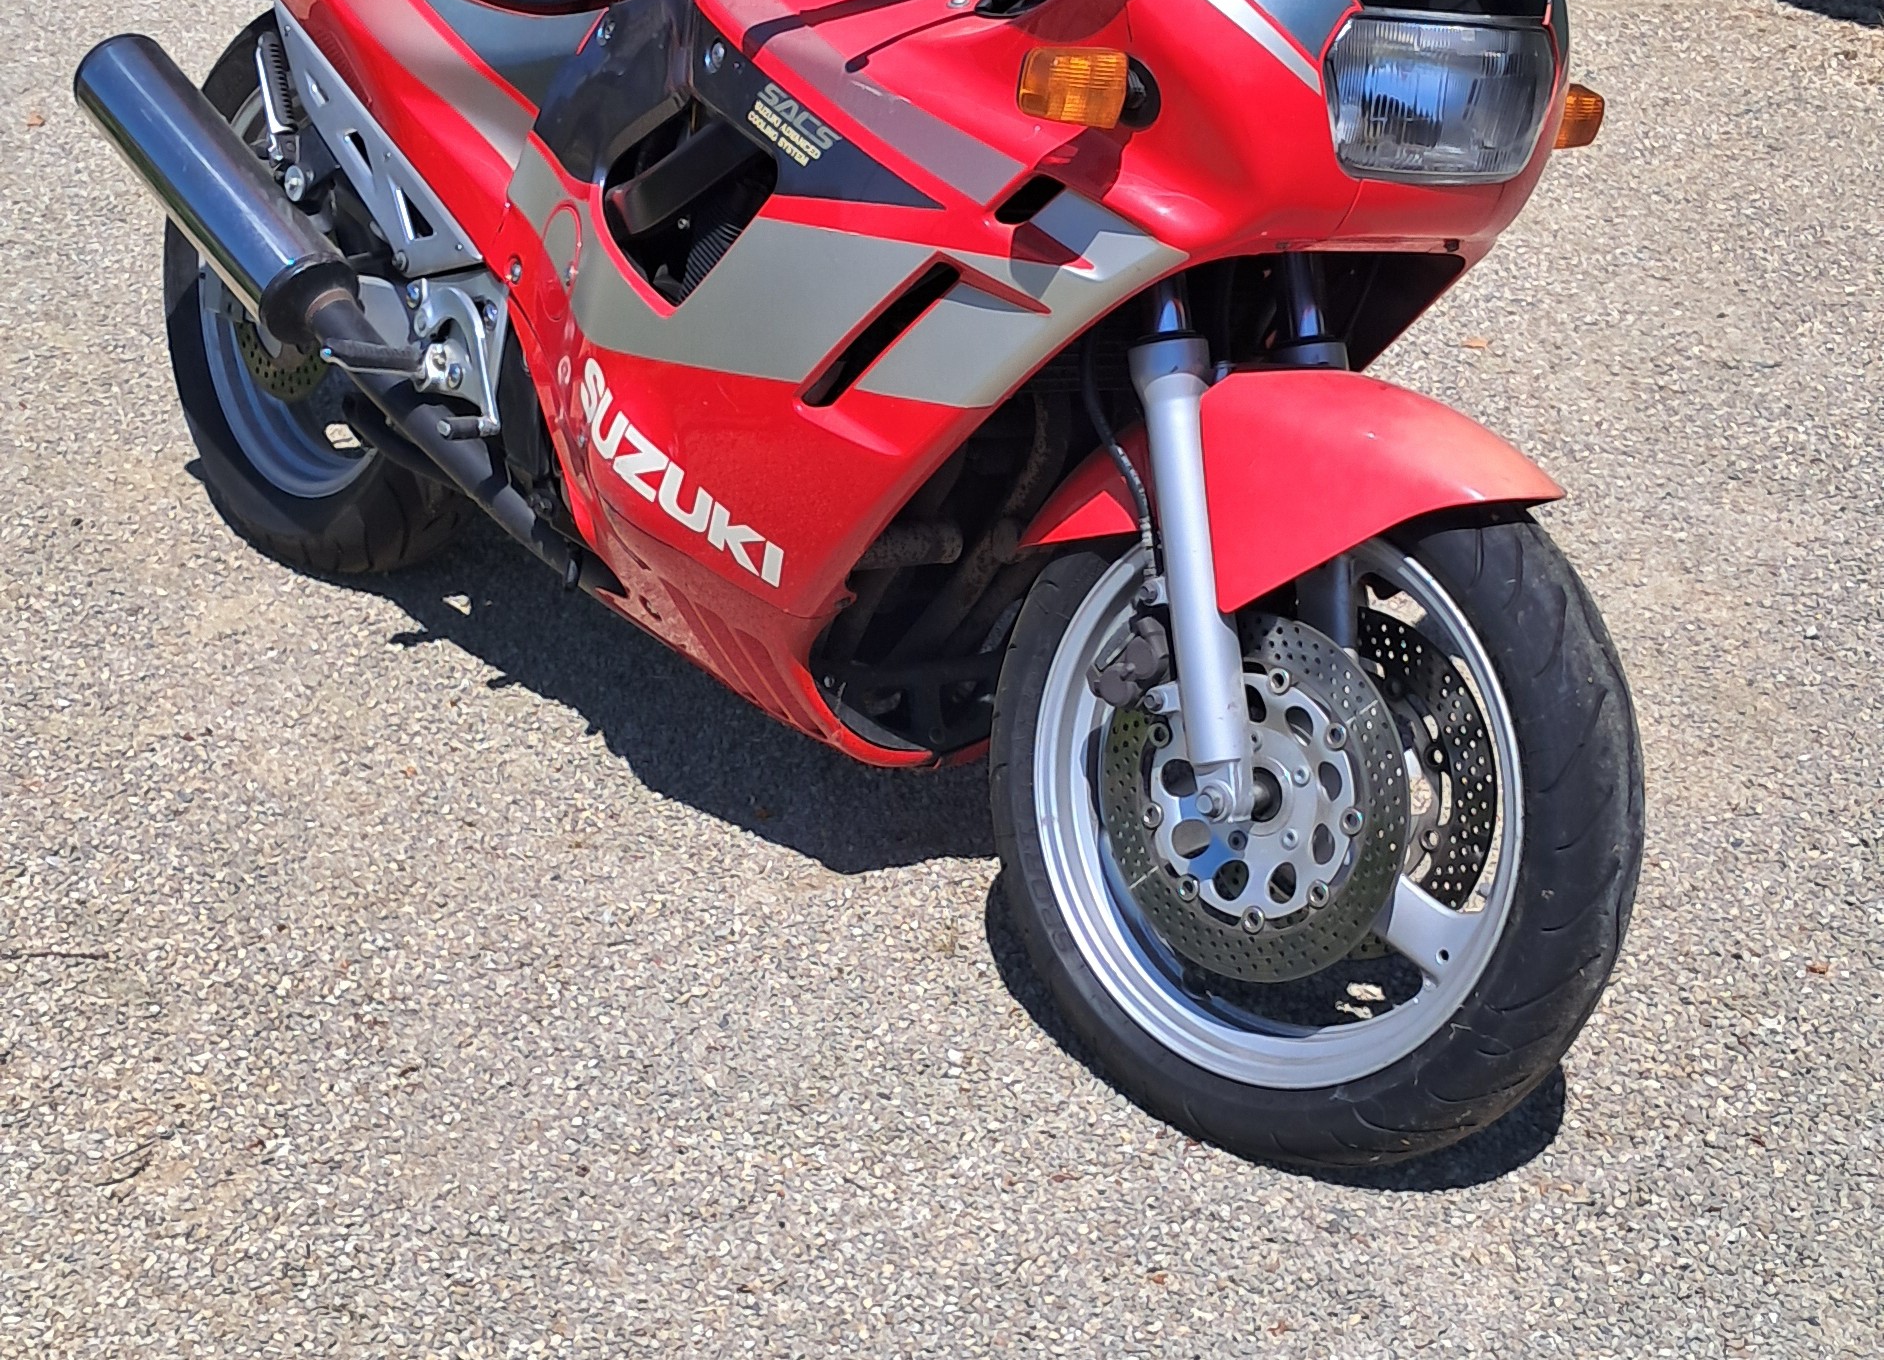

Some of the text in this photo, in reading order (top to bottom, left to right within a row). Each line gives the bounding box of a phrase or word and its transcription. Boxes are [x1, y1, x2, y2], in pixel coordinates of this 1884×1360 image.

[754, 99, 782, 128] SUZUKI
[757, 82, 843, 151] SACS
[777, 136, 810, 167] SYSTEM
[580, 357, 785, 589] SUZUKI
